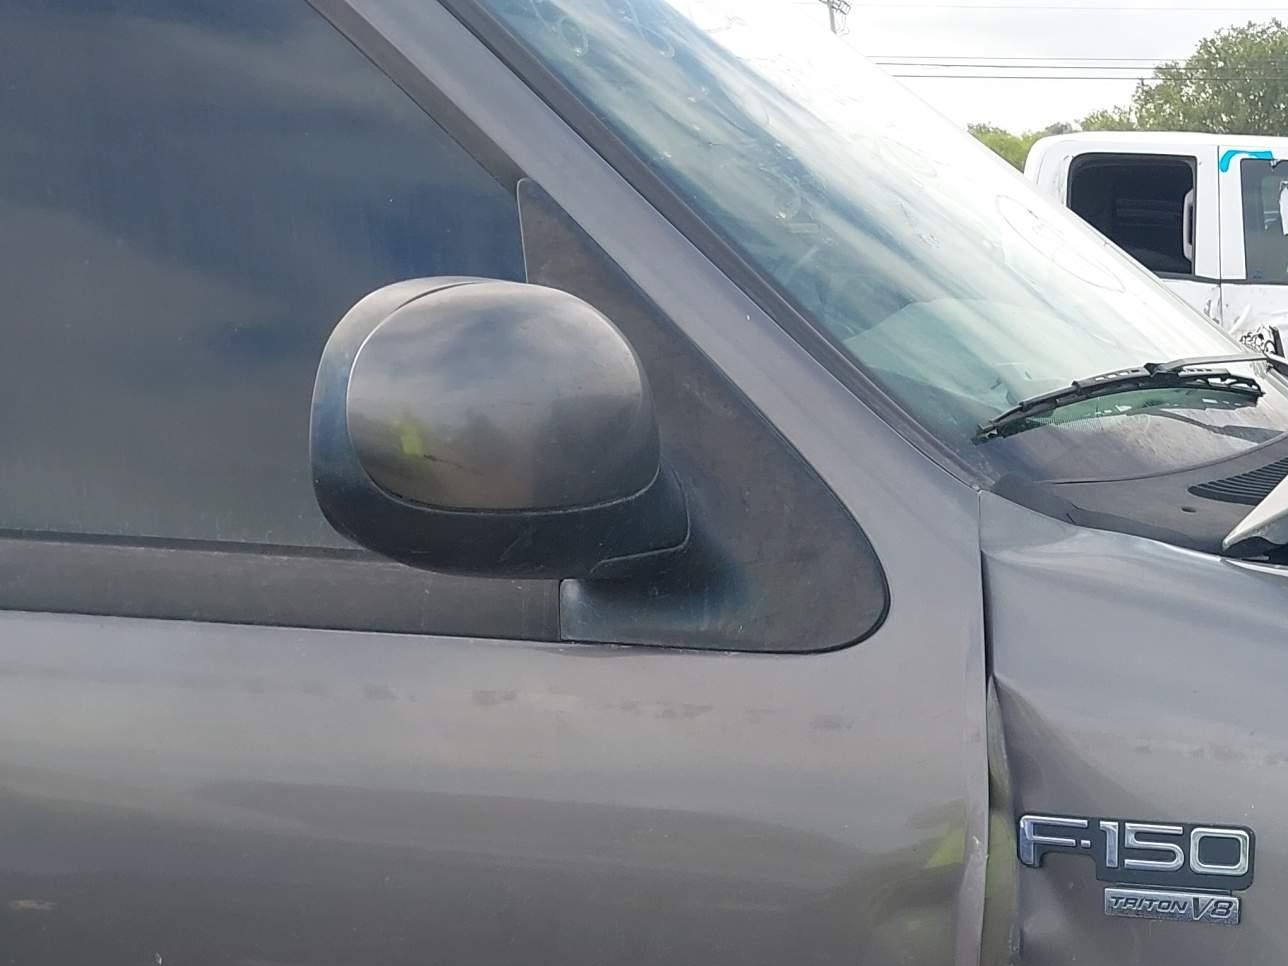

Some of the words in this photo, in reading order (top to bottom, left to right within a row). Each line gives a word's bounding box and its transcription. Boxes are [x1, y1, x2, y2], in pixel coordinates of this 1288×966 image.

[1019, 814, 1250, 876] F-150
[1110, 896, 1188, 914] TRITON
[1190, 896, 1235, 921] V8
